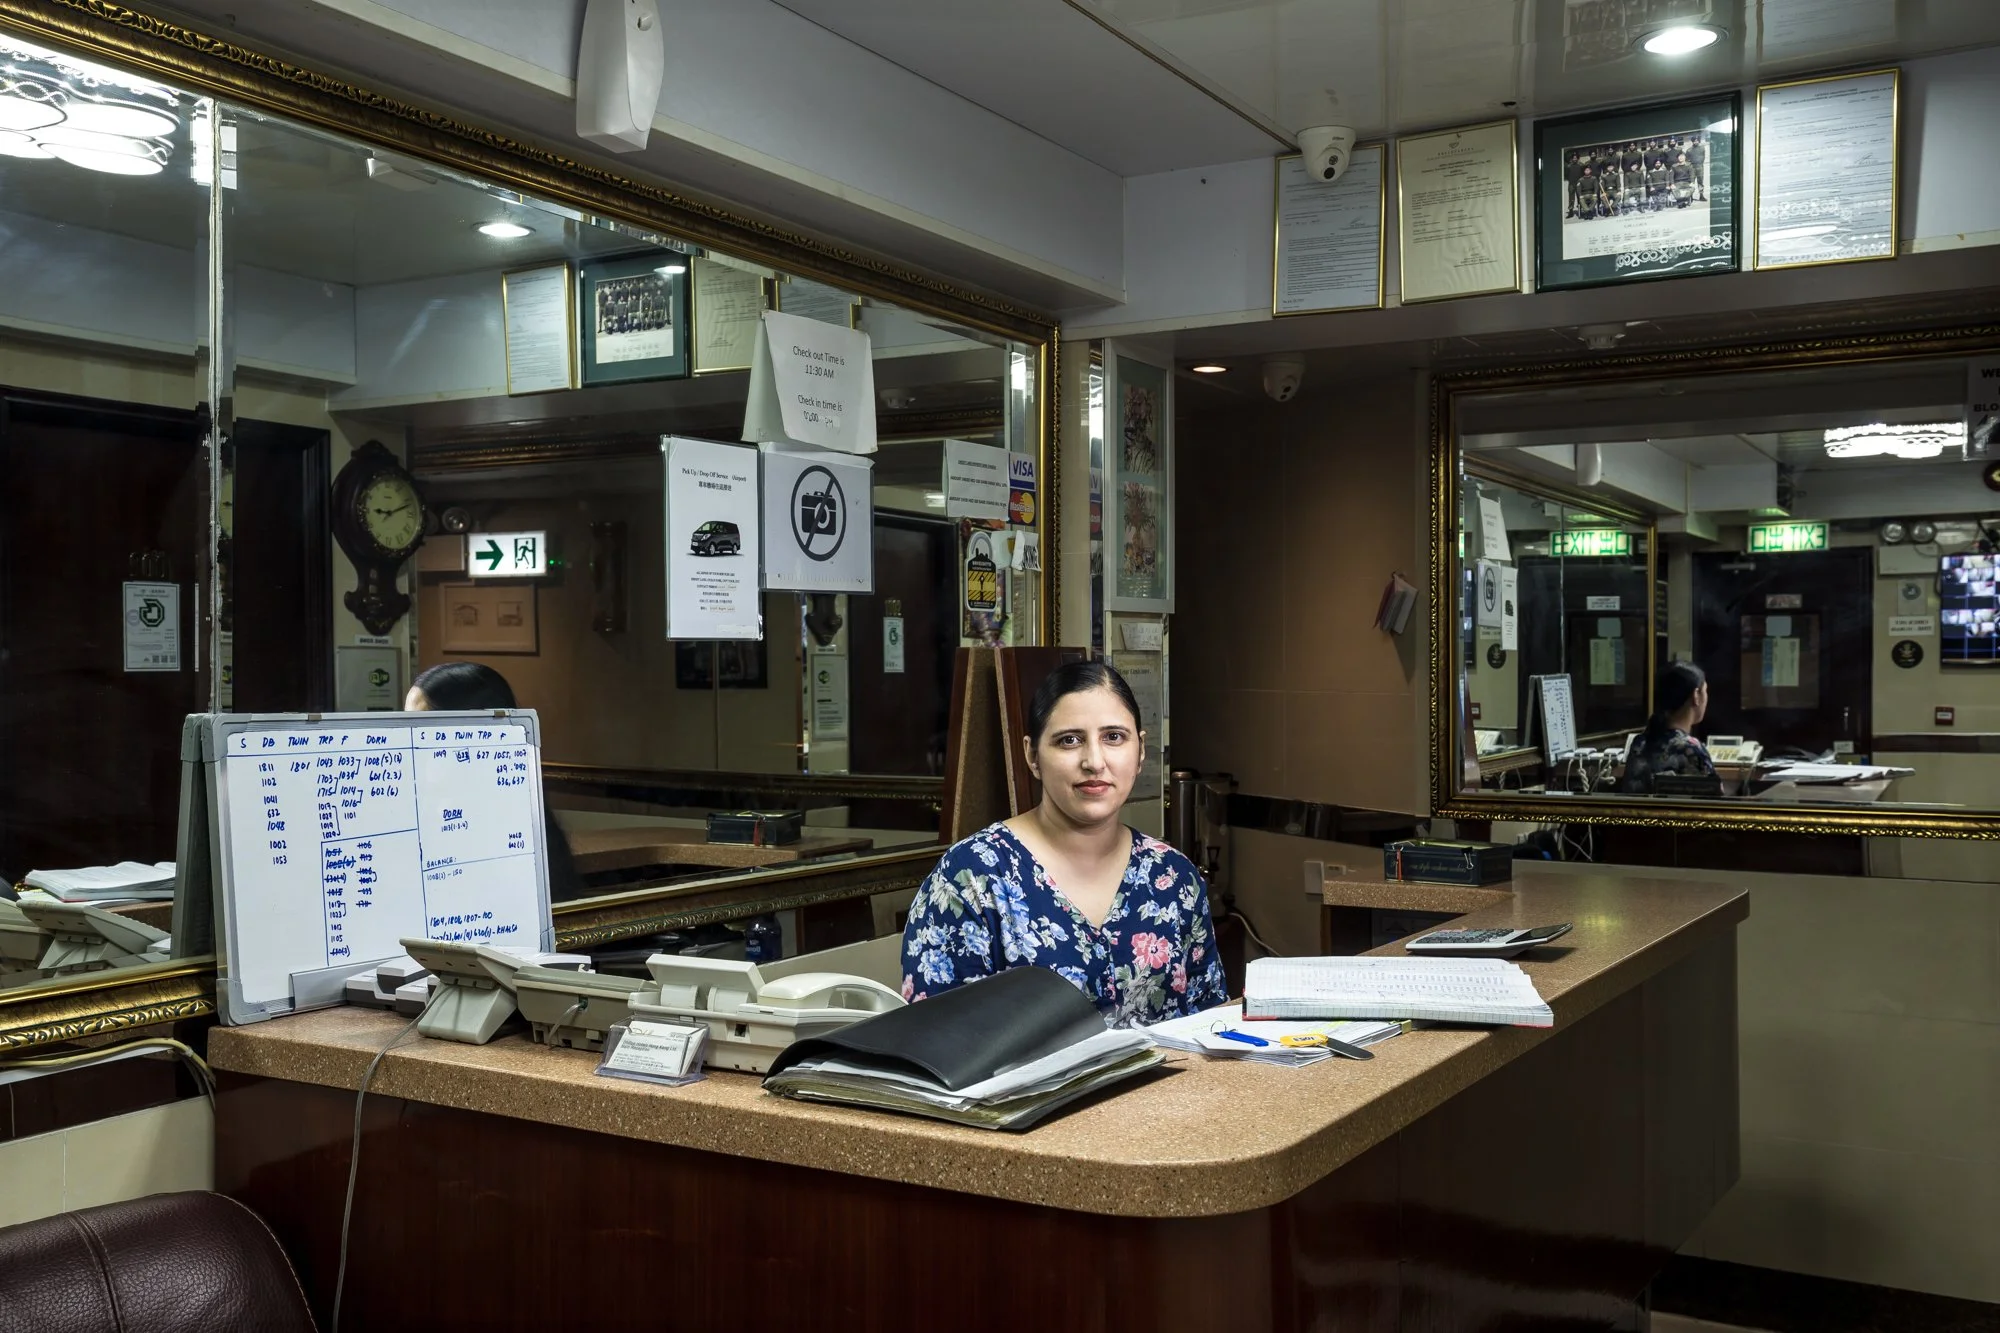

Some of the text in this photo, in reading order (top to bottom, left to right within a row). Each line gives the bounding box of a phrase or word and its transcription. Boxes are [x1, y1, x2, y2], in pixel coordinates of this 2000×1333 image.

[793, 346, 845, 366] Check out Time is
[805, 364, 834, 378] 11:30 AM
[798, 394, 842, 412] Check in time is
[1013, 460, 1034, 478] VISA
[1552, 532, 1596, 556] EXIT
[420, 730, 506, 740] S DB TWIN TRP F
[240, 738, 246, 748] S
[262, 737, 276, 748] DB
[288, 736, 310, 747] TWIN
[318, 736, 334, 745] TRP
[341, 735, 348, 745] F
[476, 750, 490, 760] 627
[259, 762, 274, 772] 1811
[290, 762, 310, 772] 1801
[317, 757, 334, 768] 1043
[262, 778, 277, 787] 1102
[340, 786, 356, 796] 1014
[267, 808, 280, 818] 632
[344, 812, 356, 820] 1101
[443, 808, 463, 819] DORM
[268, 820, 286, 832] 1048
[270, 840, 287, 850] 1002
[272, 855, 288, 865] 1053
